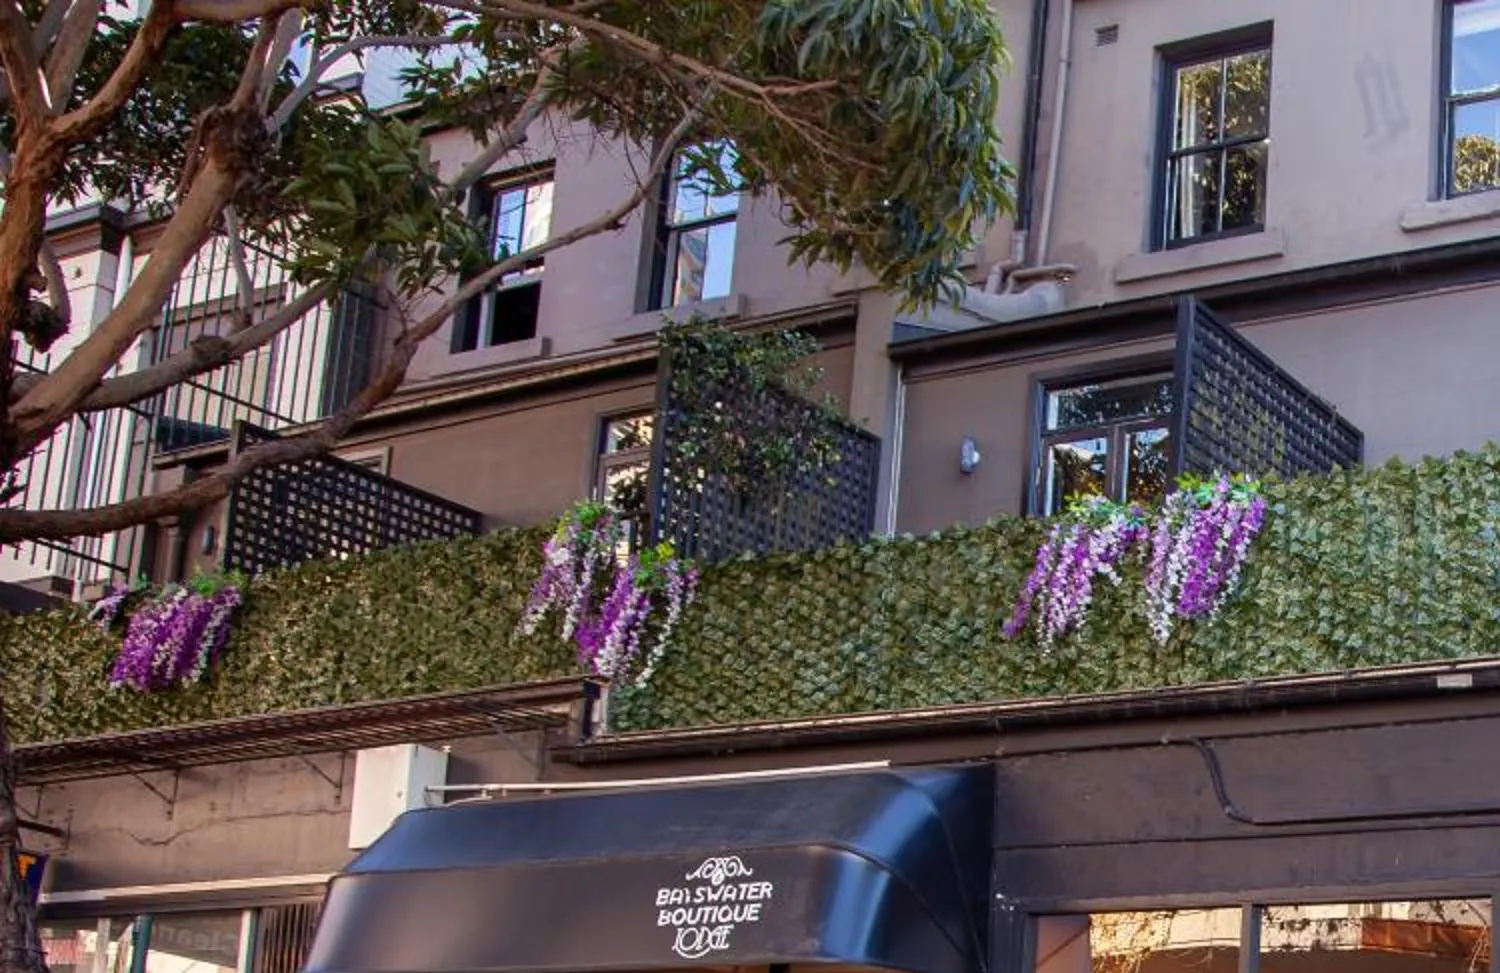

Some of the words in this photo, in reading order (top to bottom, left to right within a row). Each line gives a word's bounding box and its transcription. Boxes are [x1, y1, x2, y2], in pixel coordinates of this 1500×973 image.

[655, 881, 773, 906] BAYSWATER
[657, 903, 762, 926] BOUTIQUE
[672, 925, 734, 959] LODGE
